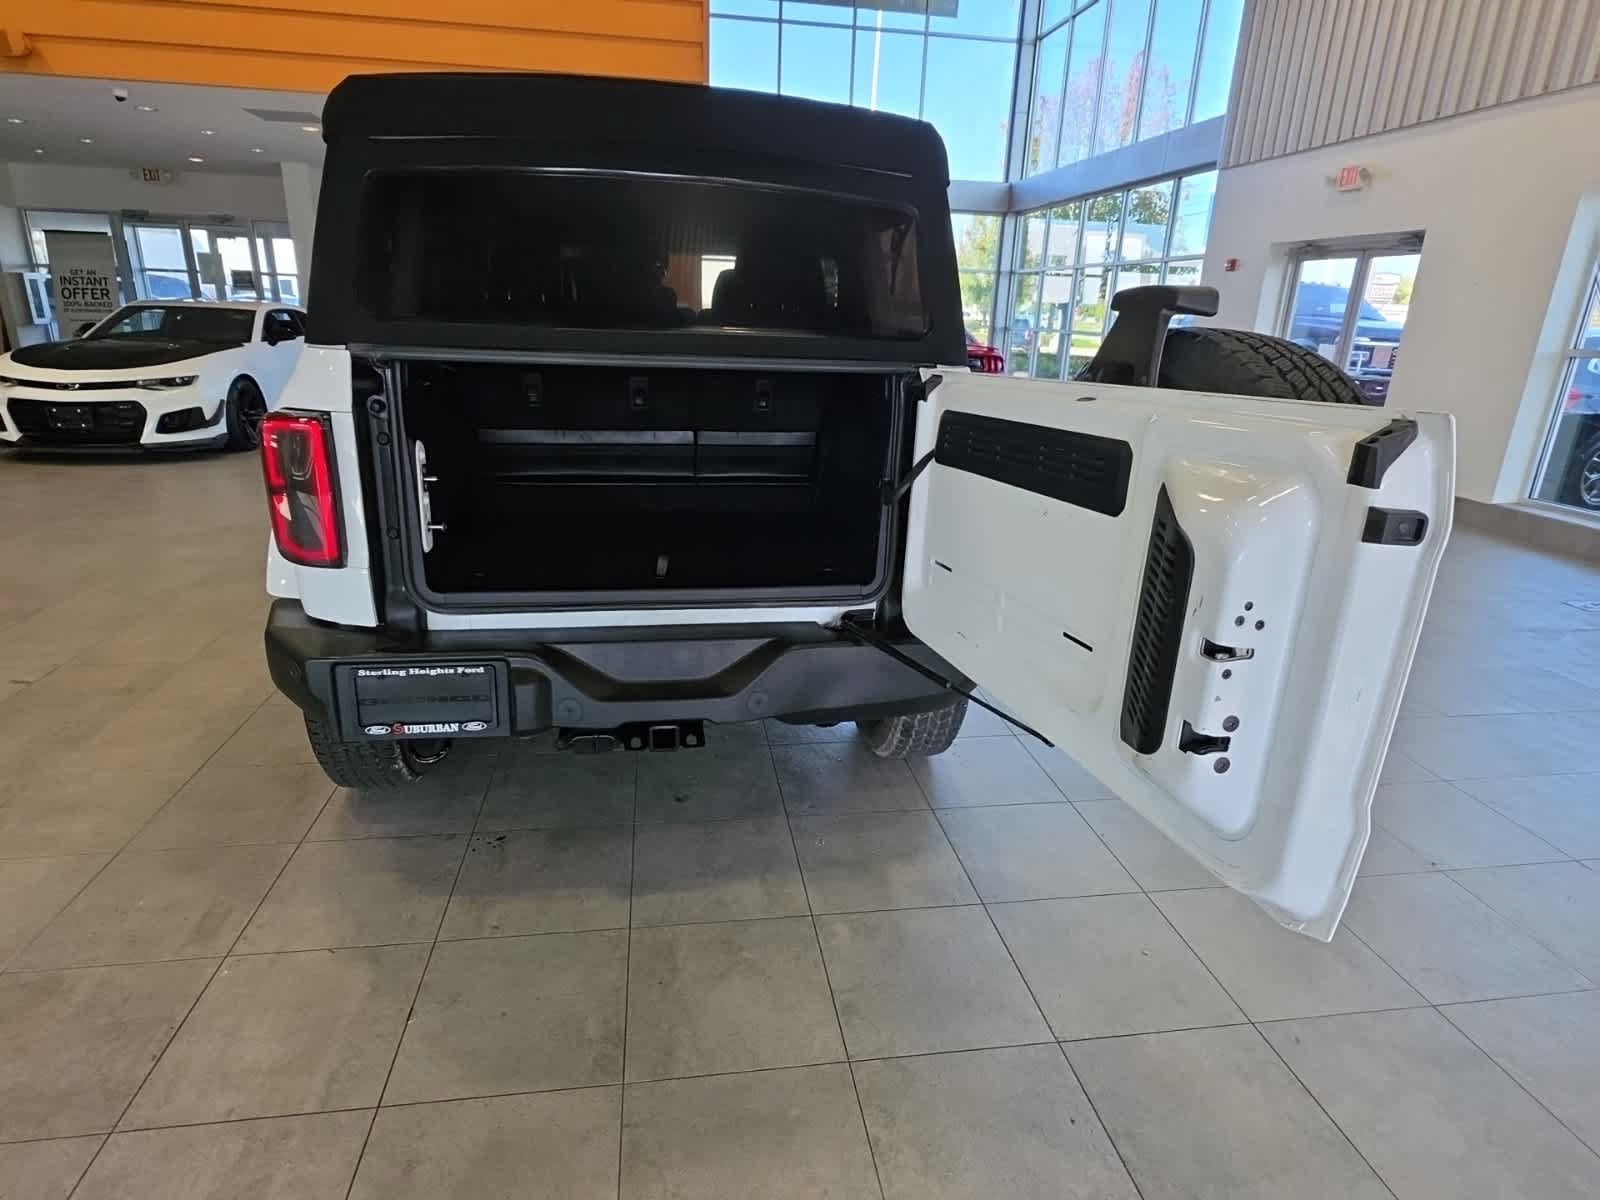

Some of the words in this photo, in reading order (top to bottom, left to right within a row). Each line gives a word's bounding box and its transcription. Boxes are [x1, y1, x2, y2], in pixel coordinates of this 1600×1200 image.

[60, 275, 109, 287] INSTANT
[61, 287, 111, 300] OFFER
[408, 667, 455, 676] Heights
[457, 666, 485, 674] Ford
[392, 723, 460, 735] SUBURBAN
